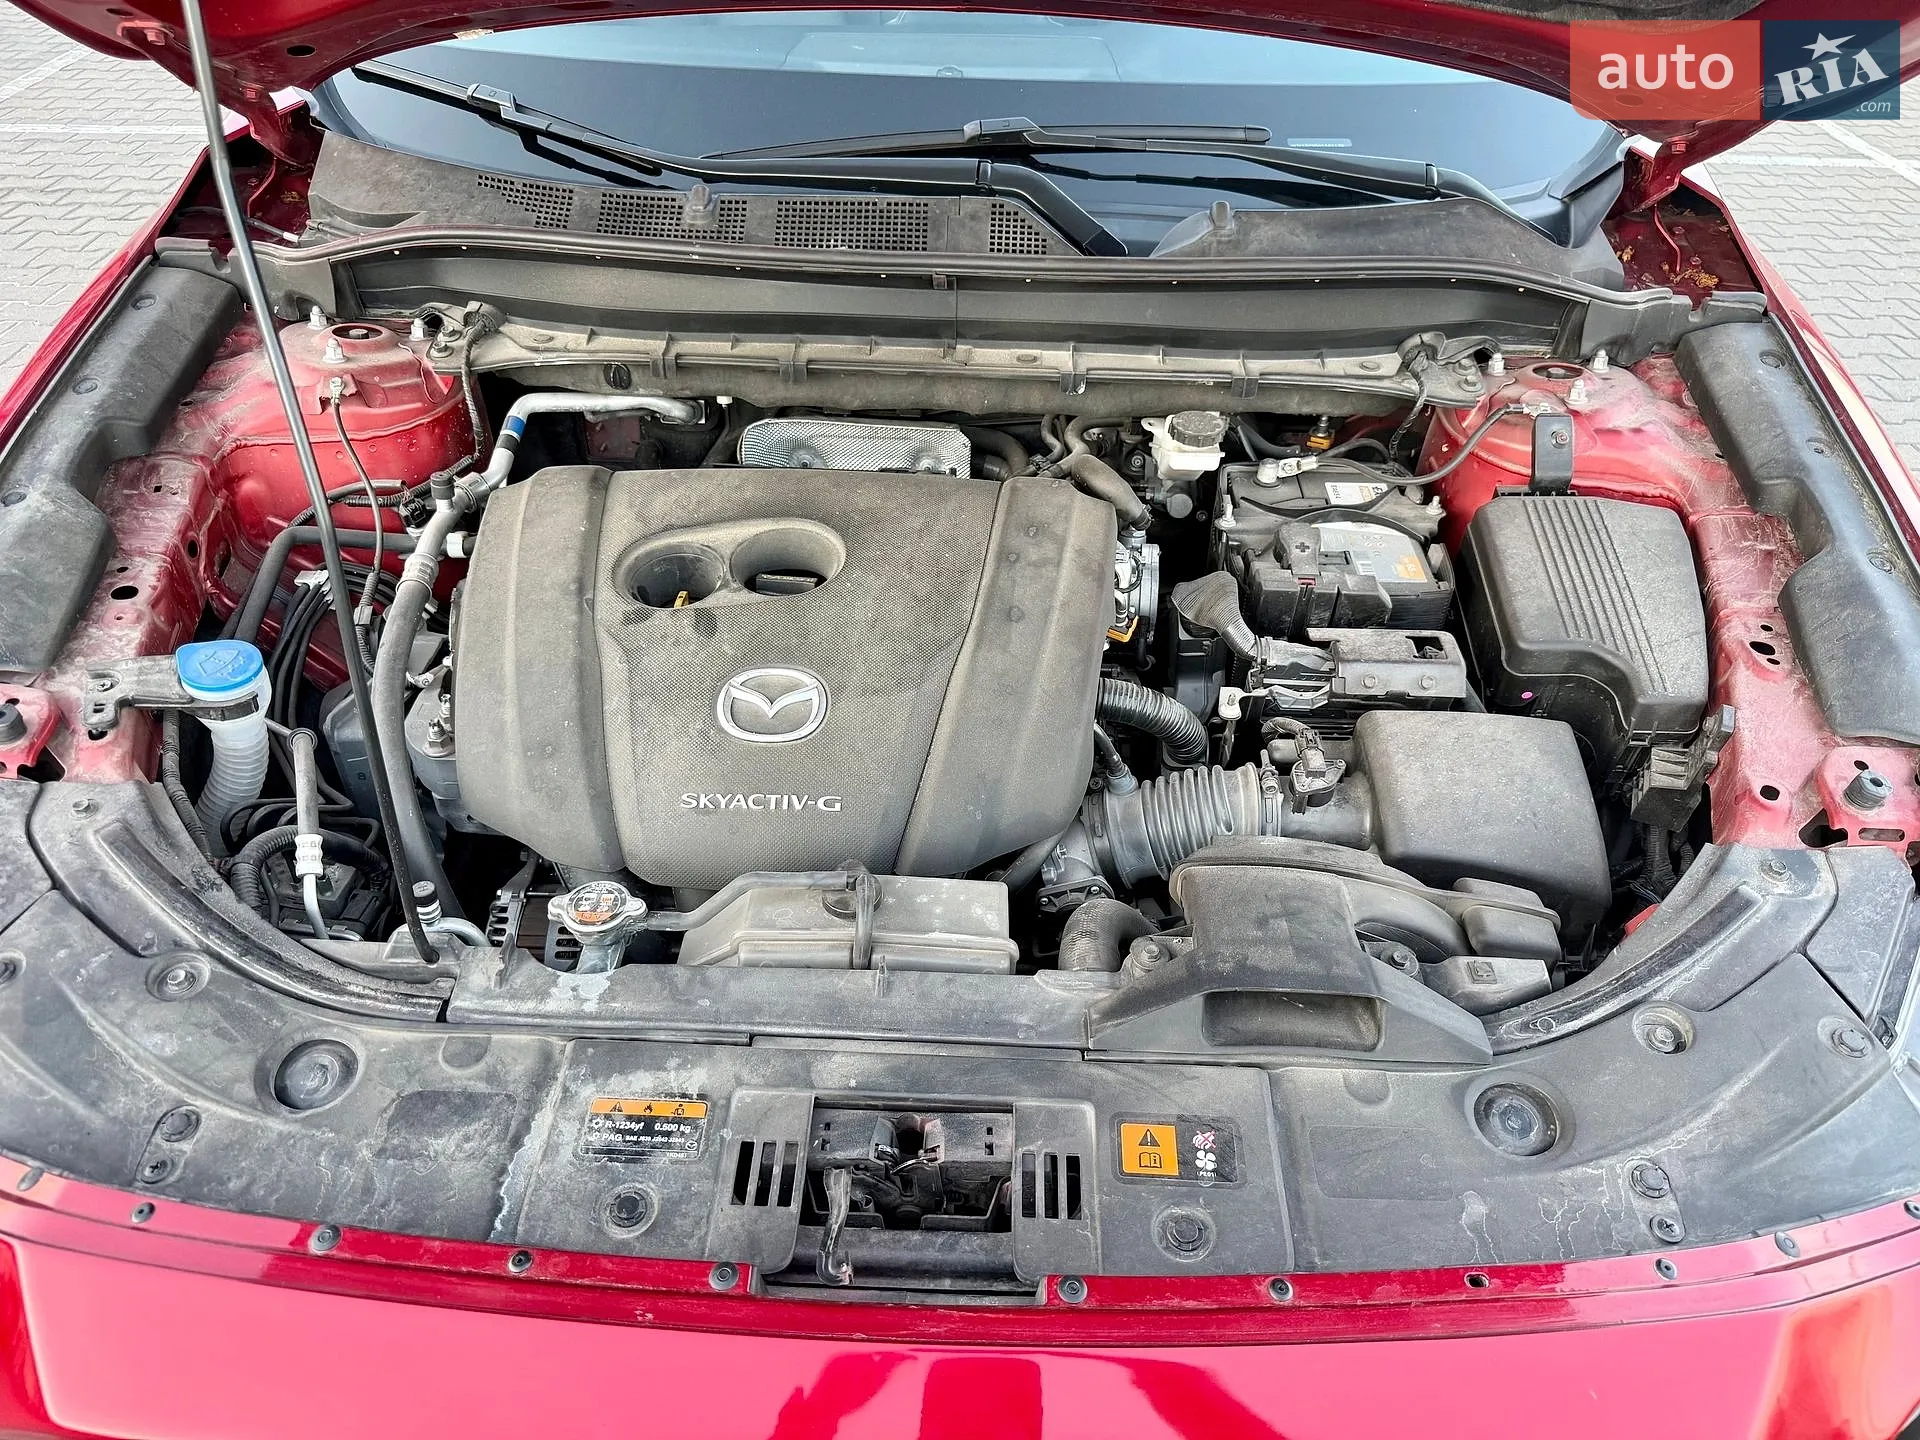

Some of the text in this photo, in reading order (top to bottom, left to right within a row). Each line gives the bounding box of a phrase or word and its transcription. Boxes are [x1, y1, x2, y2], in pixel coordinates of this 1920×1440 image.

[680, 792, 842, 813] SKYACTIV-G
[604, 1120, 692, 1134] R-1234yf 0.500 kg
[602, 1133, 623, 1142] PAG
